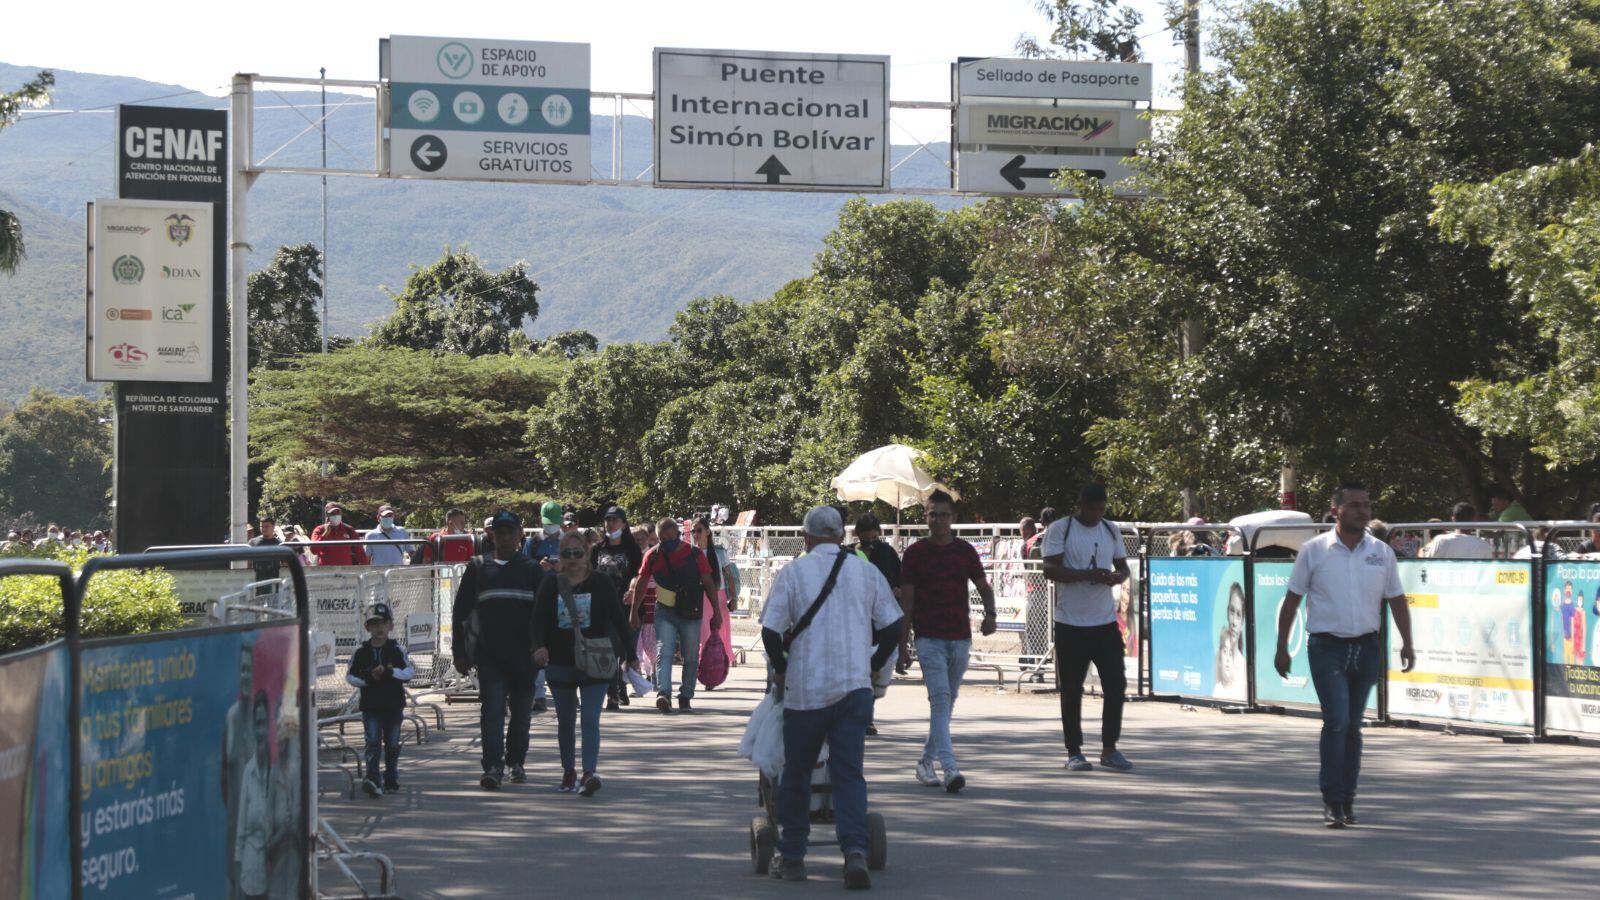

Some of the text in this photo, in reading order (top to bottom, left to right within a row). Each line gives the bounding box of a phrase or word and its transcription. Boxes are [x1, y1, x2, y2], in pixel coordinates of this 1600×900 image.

[482, 48, 536, 62] ESPACIO
[482, 64, 546, 78] DE APOYO
[721, 62, 825, 84] Puente
[976, 68, 1140, 87] Sellado de Pasaporte
[672, 94, 868, 118] Internacional
[987, 114, 1098, 131] MIGRACIÓN
[125, 126, 223, 161] CENAF
[670, 125, 876, 151] Simón Bolívar
[483, 141, 568, 156] SERVICIOS
[130, 162, 217, 174] CENTRO NACIONAL DE
[479, 158, 572, 173] GRATUITOS
[125, 170, 222, 184] ATENCIÓN EN FRONTERAS
[172, 268, 200, 278] DIAN
[162, 306, 183, 320] ica
[126, 394, 165, 402] REPÚBLICA
[178, 396, 220, 404] COLOMBIA
[132, 404, 156, 412] NORTE
[170, 405, 214, 413] SANTANDER
[1168, 572, 1176, 586] de
[1176, 572, 1184, 587] los
[1185, 572, 1198, 587] más
[1258, 574, 1274, 586] Todos
[1276, 574, 1284, 586] los
[1181, 593, 1189, 604] no
[1189, 590, 1198, 604] los
[1174, 606, 1182, 621] de
[158, 647, 196, 682] unido
[96, 707, 120, 741] tus
[124, 695, 194, 734] familiares
[81, 750, 152, 800] y amigos
[81, 780, 184, 848] y estarás más
[81, 846, 139, 890] seguro.
